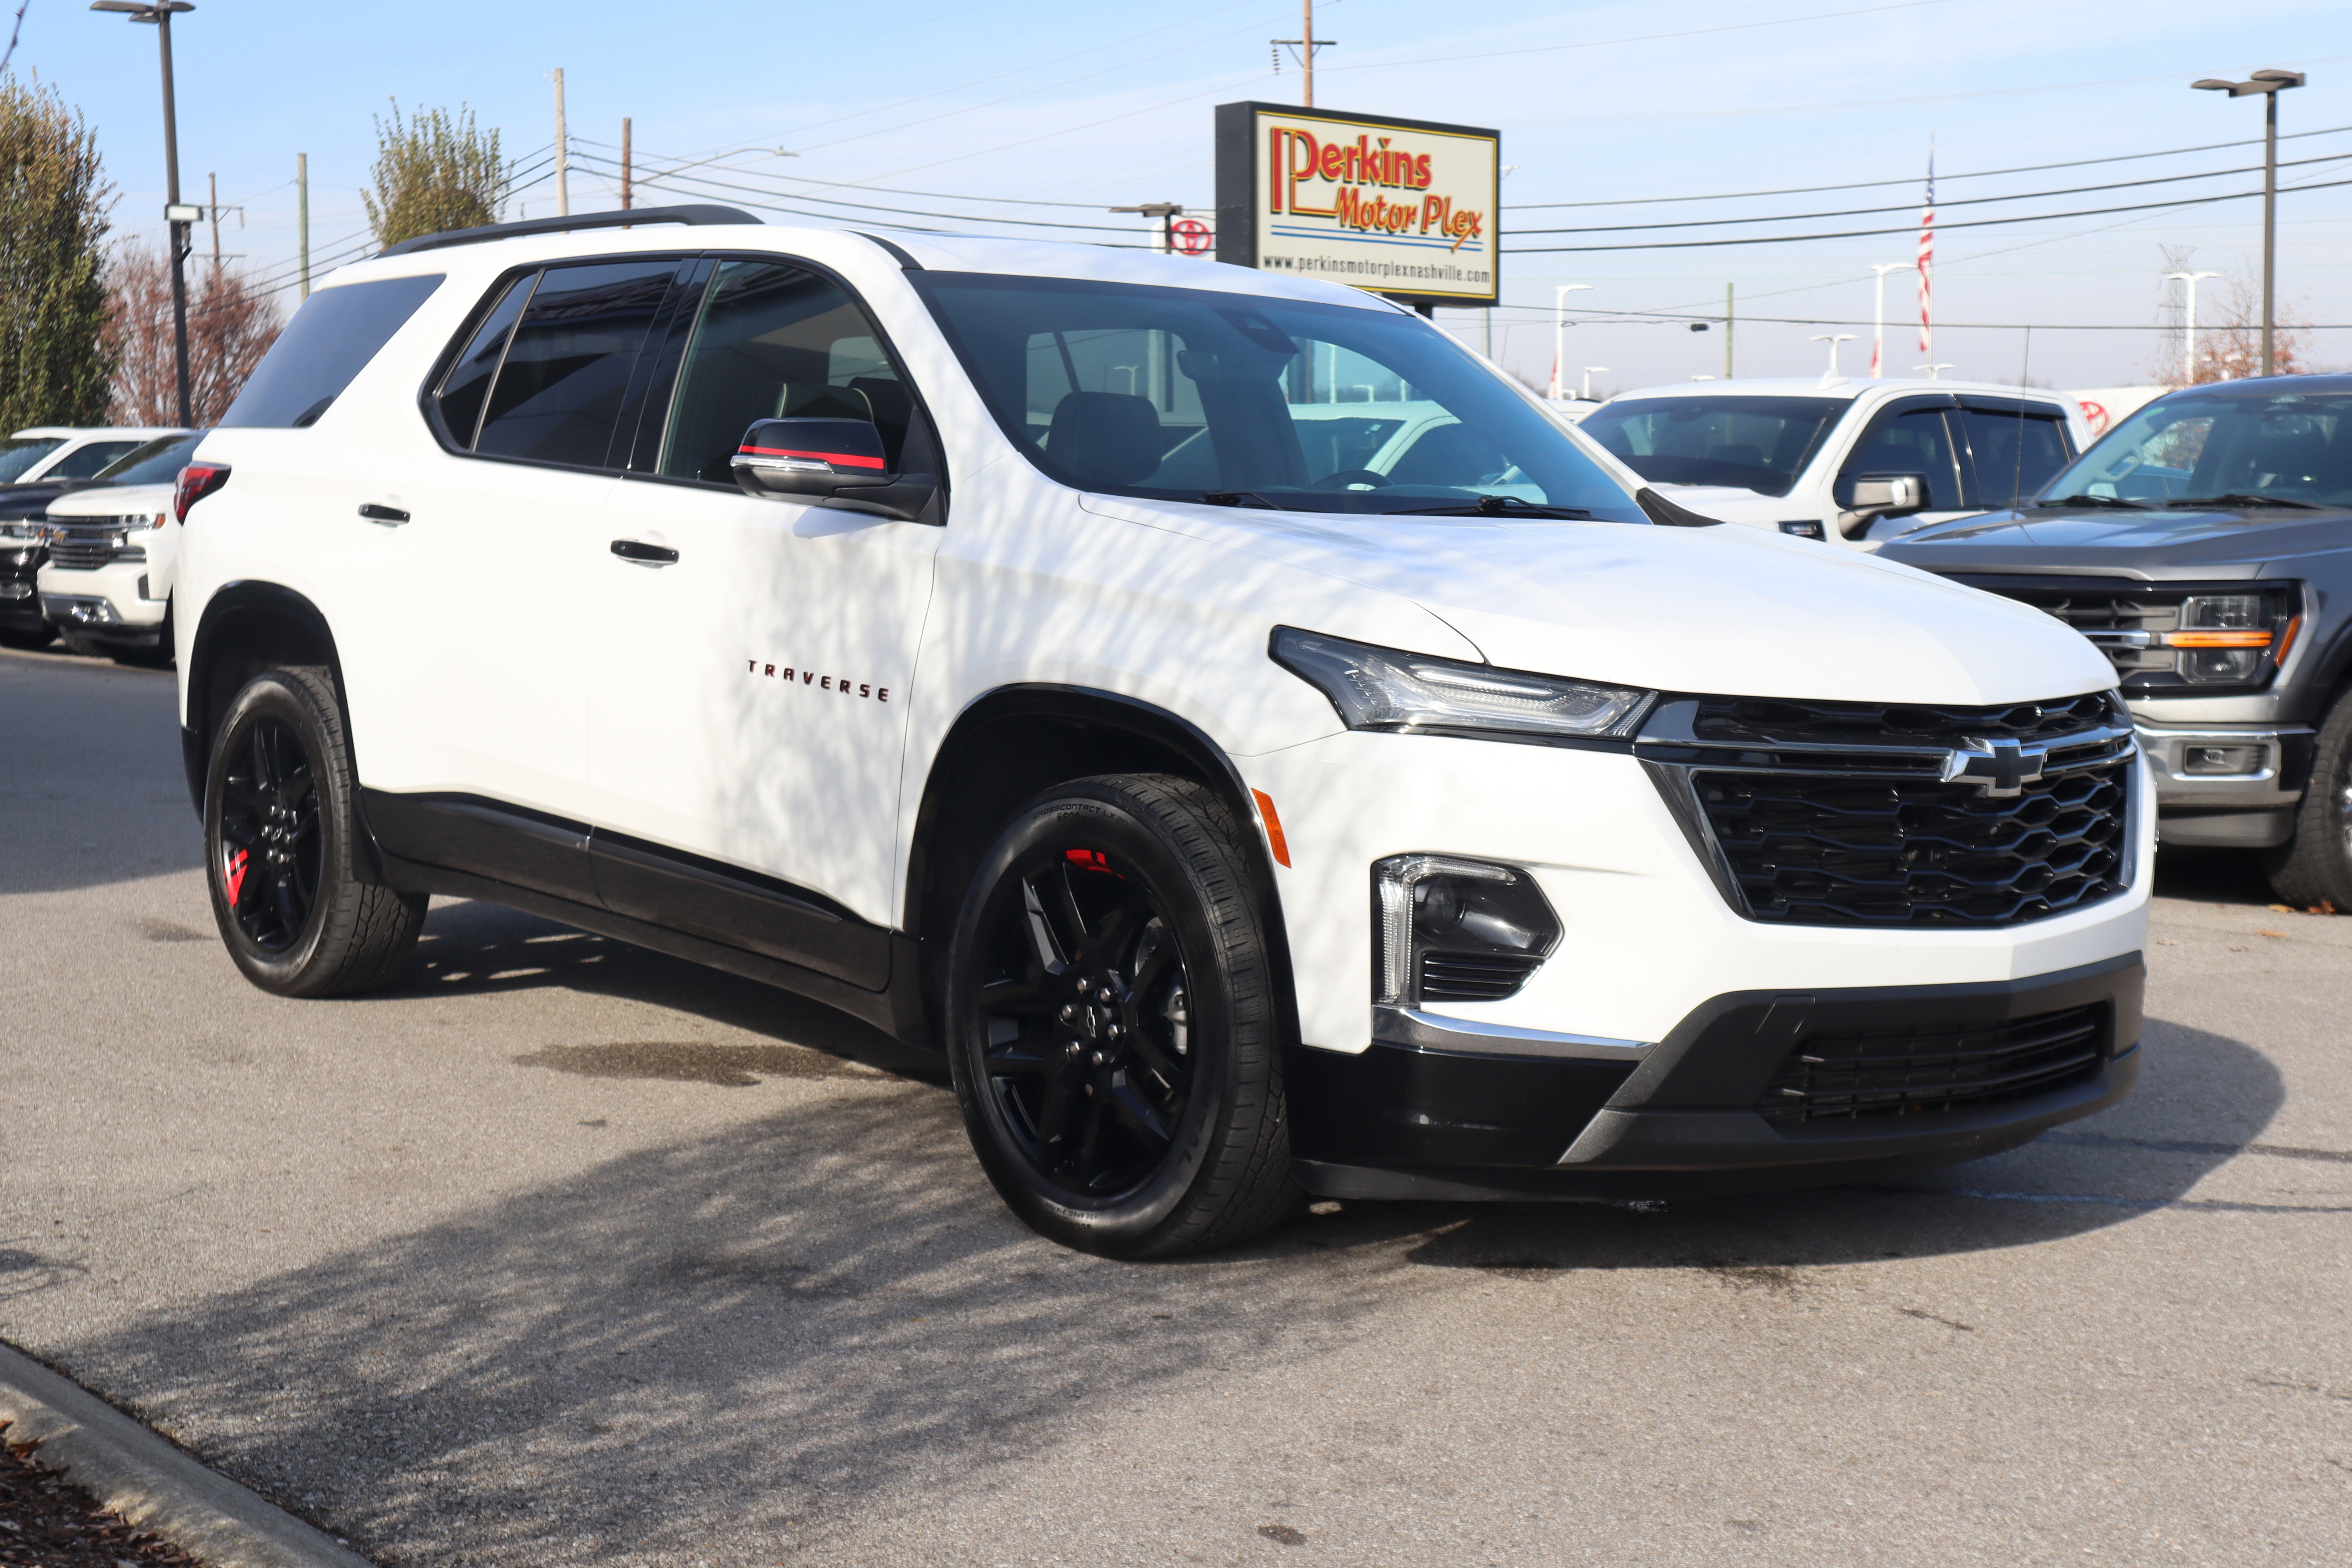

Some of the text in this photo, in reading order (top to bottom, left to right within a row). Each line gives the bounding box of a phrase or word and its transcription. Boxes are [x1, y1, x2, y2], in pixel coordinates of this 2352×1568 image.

[1271, 125, 1433, 214] Perkins
[1335, 186, 1483, 252] Motor Plex
[1264, 255, 1490, 283] www.perkinsmotorplexnashville.com
[748, 659, 889, 702] TRAVERSE
[1033, 803, 1101, 820] CROSSCONTACT
[1103, 810, 1116, 820] LX
[1116, 816, 1129, 827] 20
